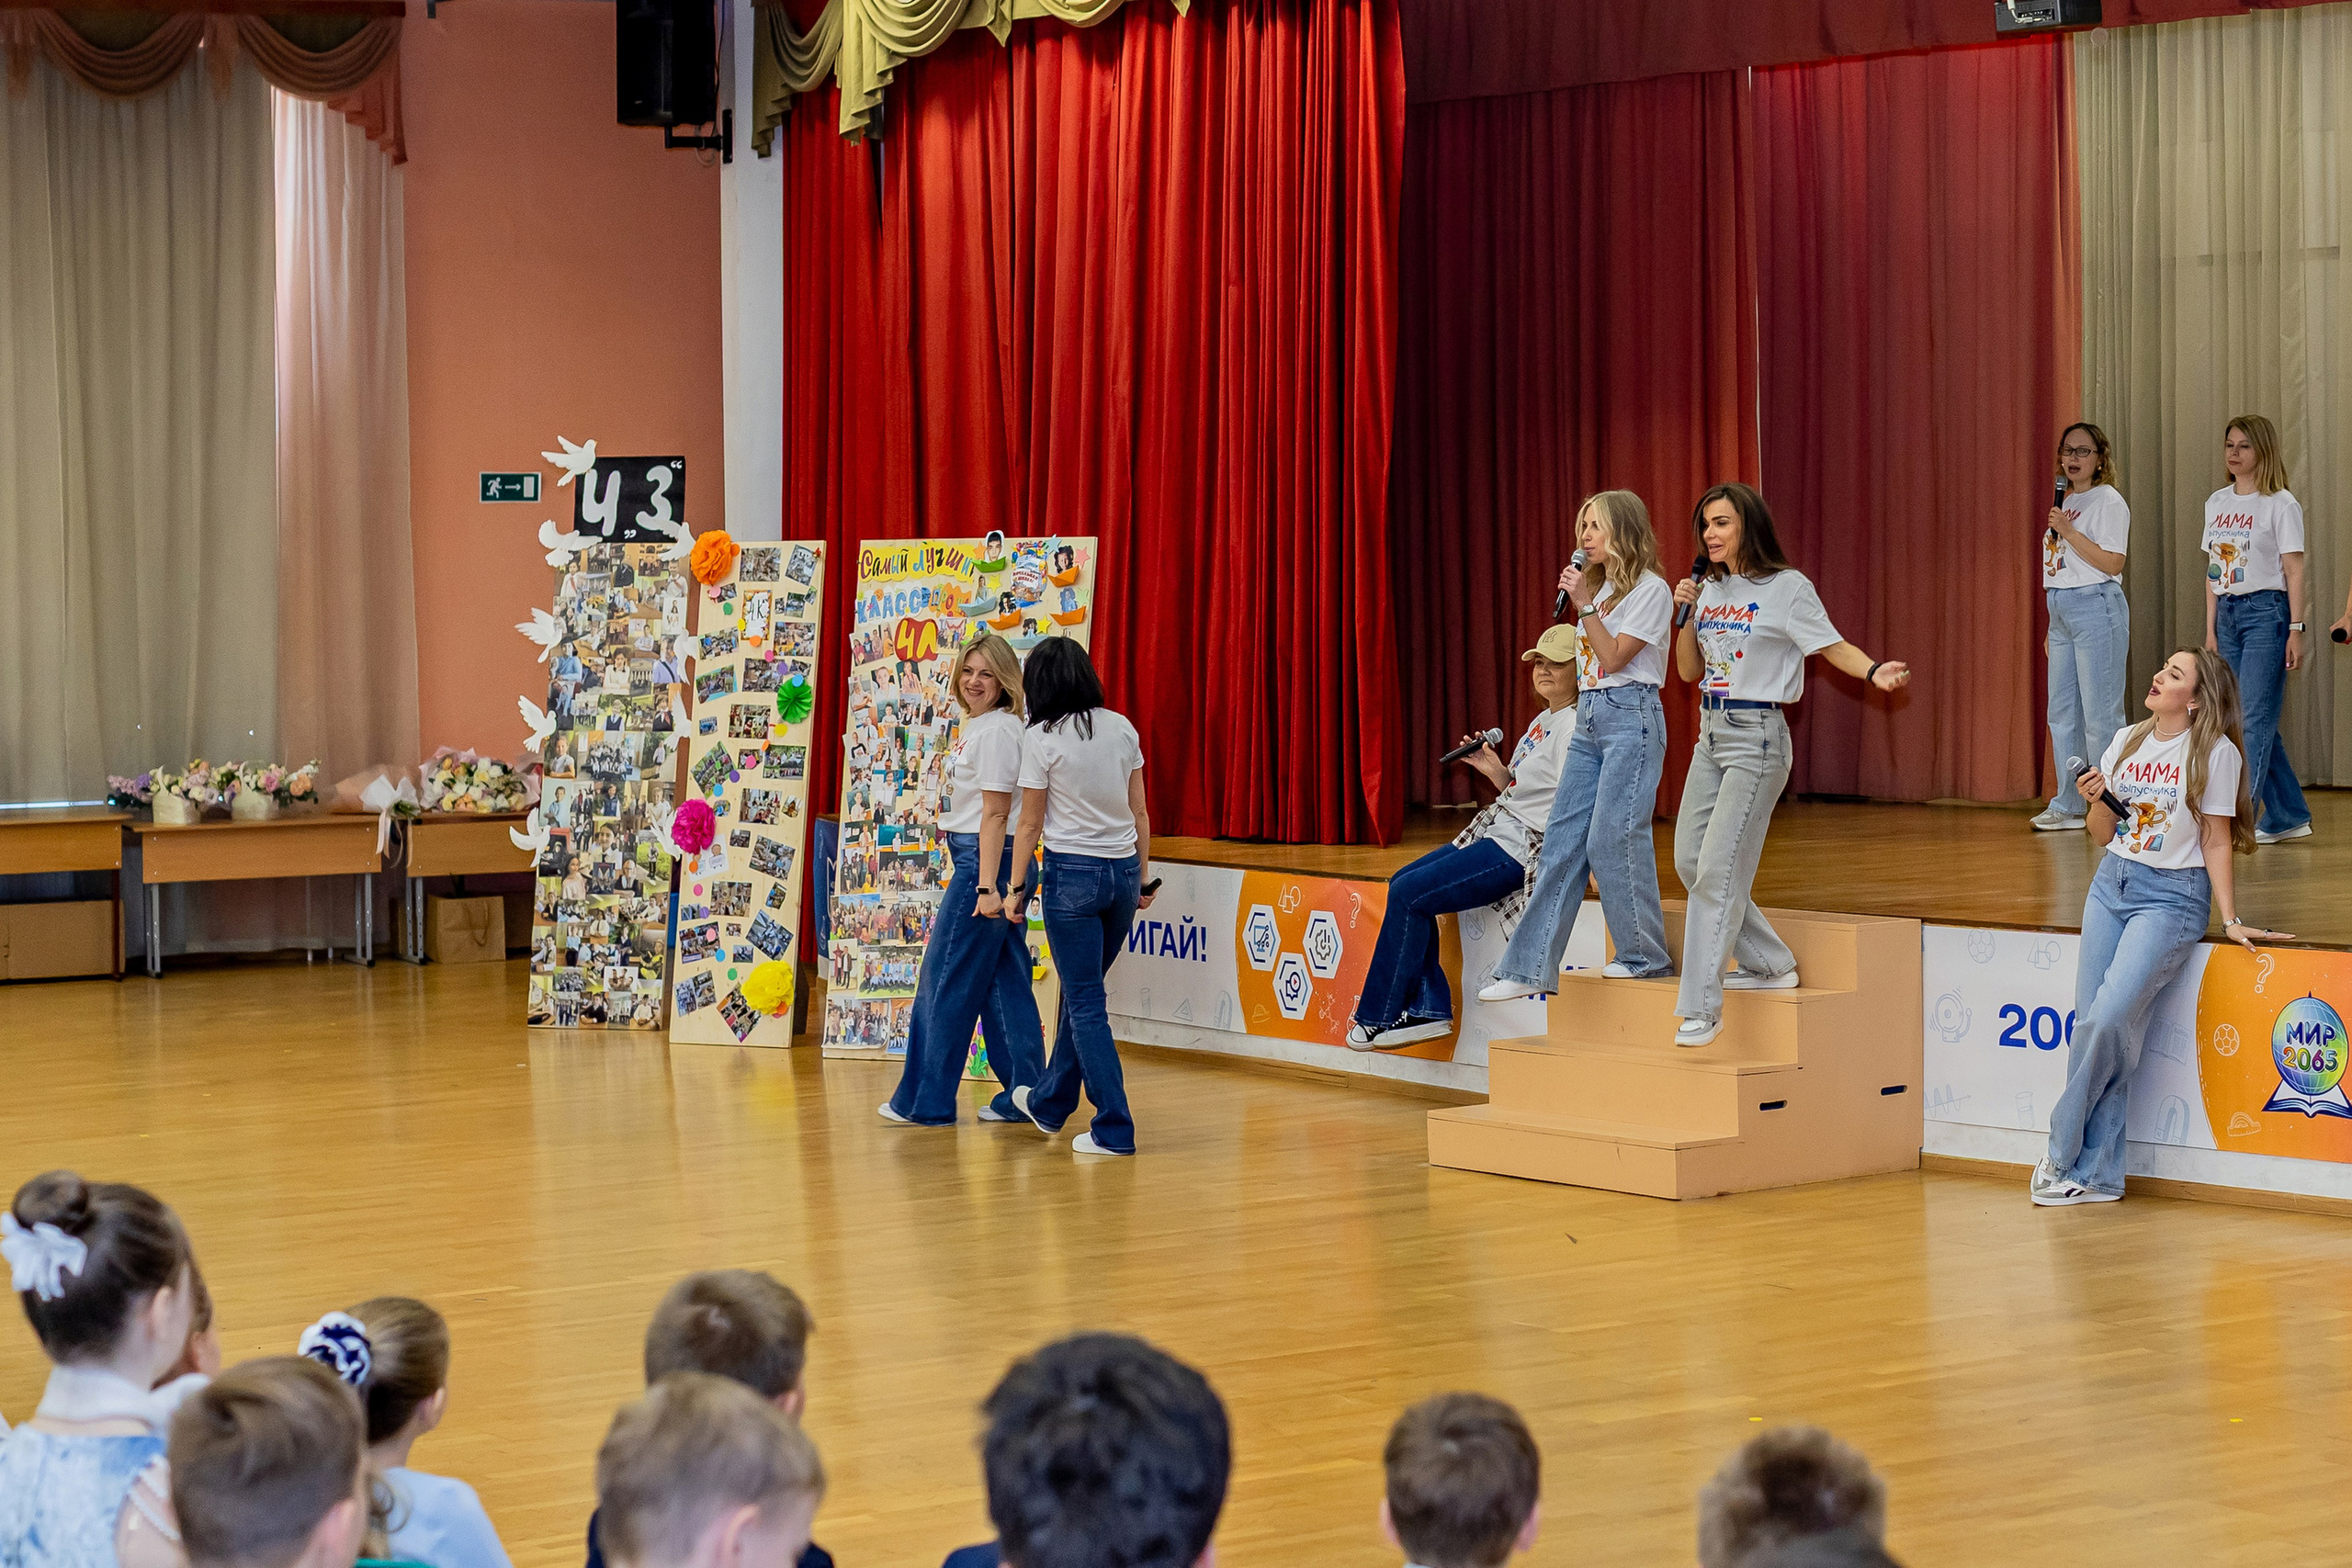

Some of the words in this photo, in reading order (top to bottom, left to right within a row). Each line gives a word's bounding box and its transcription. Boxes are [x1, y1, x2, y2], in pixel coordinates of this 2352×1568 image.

[2208, 530, 2250, 539] ыпускника
[860, 548, 910, 579] Самый
[1700, 604, 1754, 623] МАМА
[2121, 761, 2180, 785] МАМА
[2286, 1021, 2336, 1047] МИР
[2283, 1046, 2339, 1073] 2065
